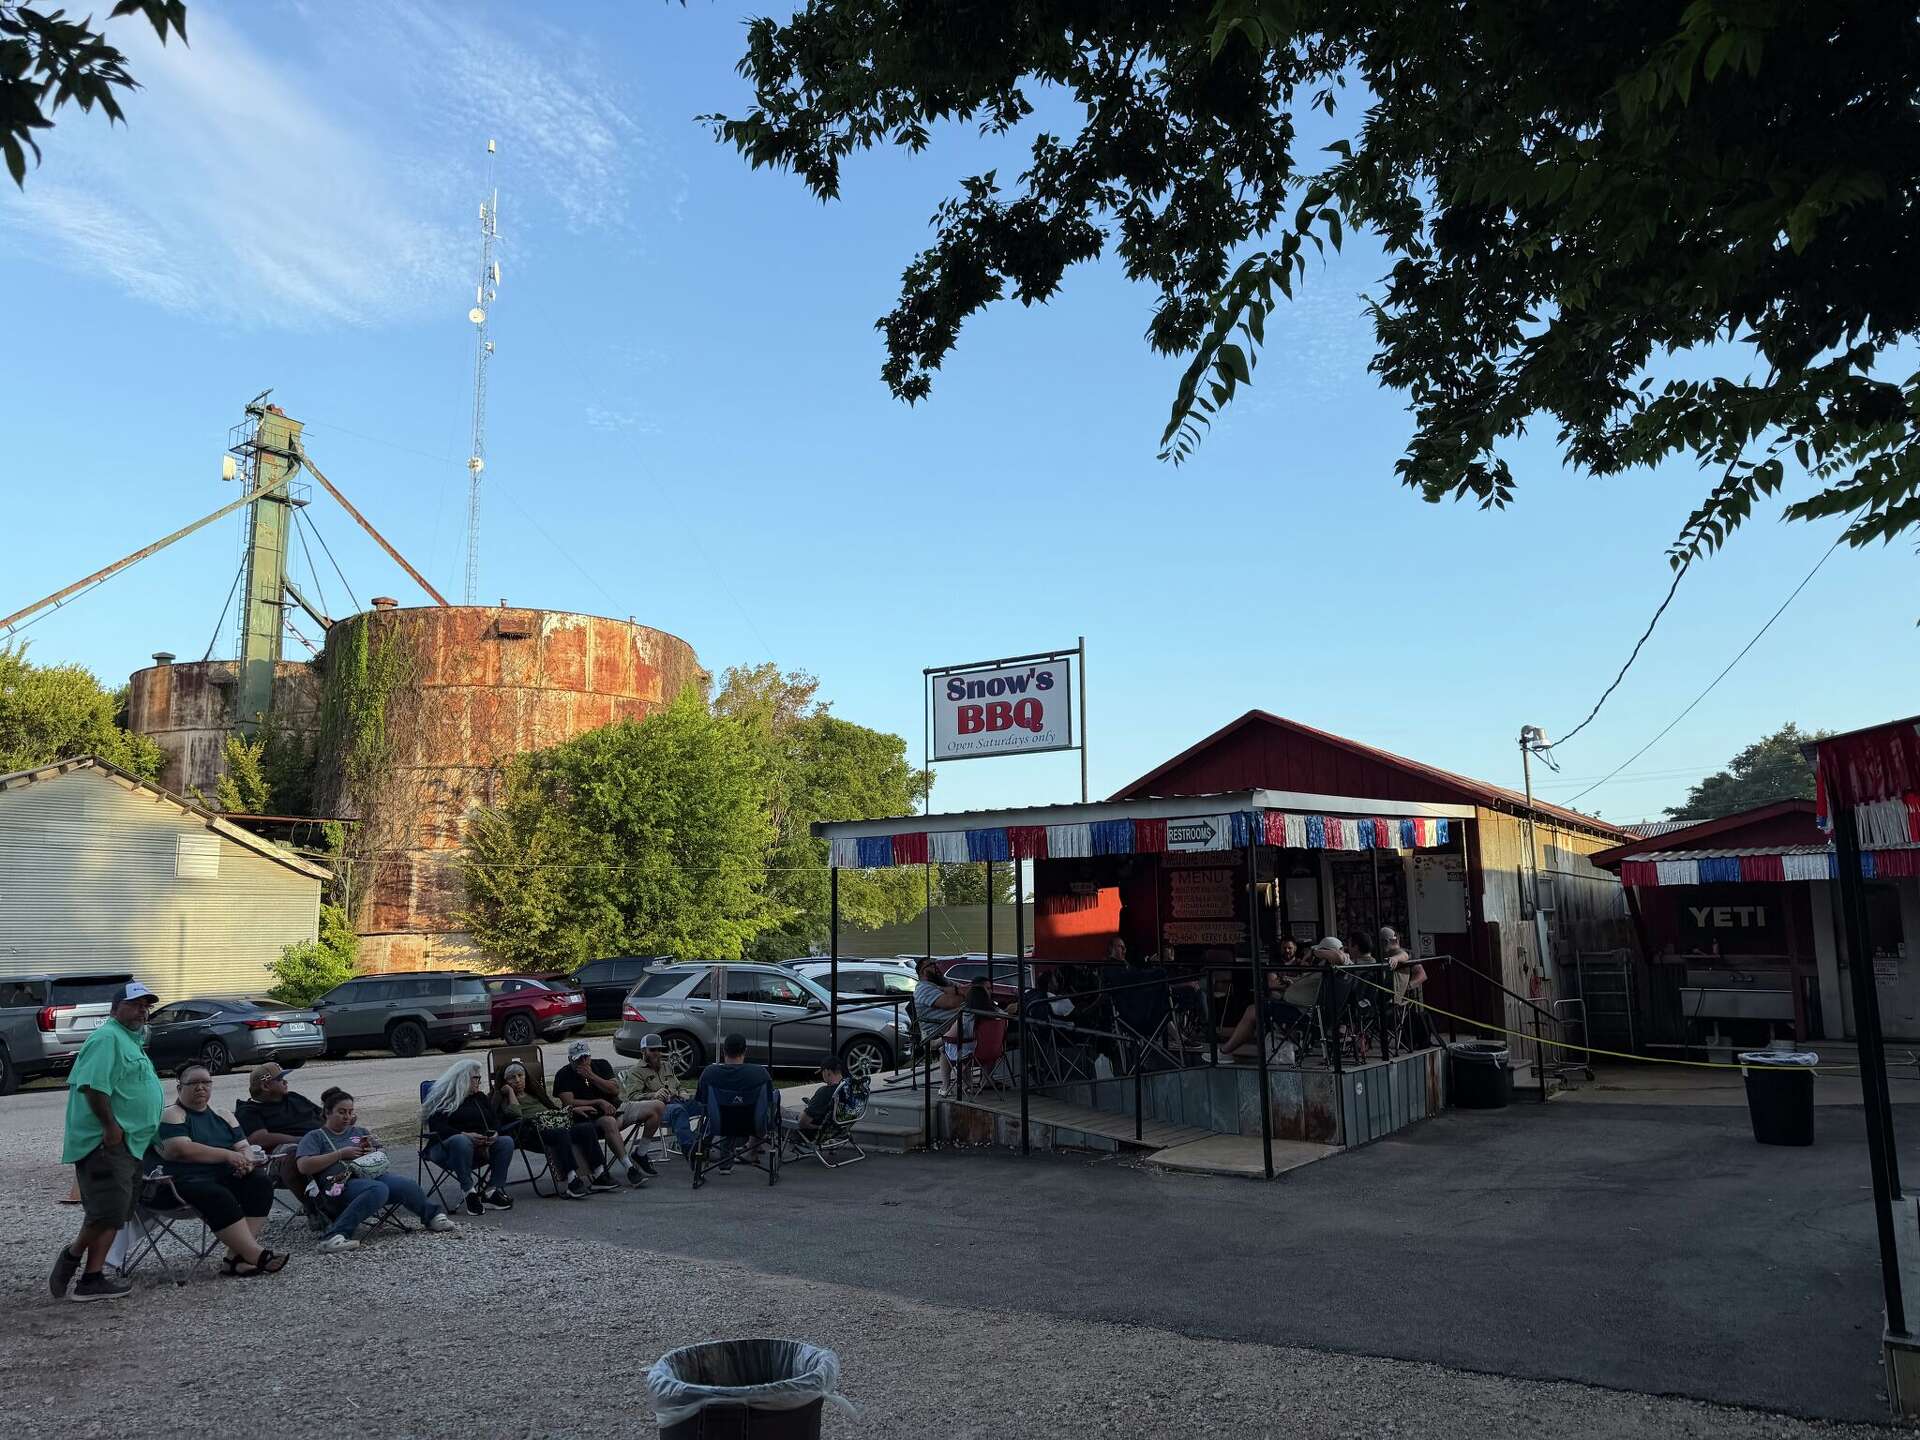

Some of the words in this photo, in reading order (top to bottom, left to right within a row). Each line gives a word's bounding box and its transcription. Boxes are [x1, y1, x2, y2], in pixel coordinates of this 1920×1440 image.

[947, 668, 1054, 701] Snow's
[958, 697, 1043, 734] BBQ
[947, 740, 974, 752] Open
[975, 734, 1029, 749] Saturdays
[1032, 730, 1056, 744] only
[1168, 827, 1211, 841] RESTROOMS
[1179, 871, 1223, 884] MENU
[1688, 906, 1766, 927] YETI
